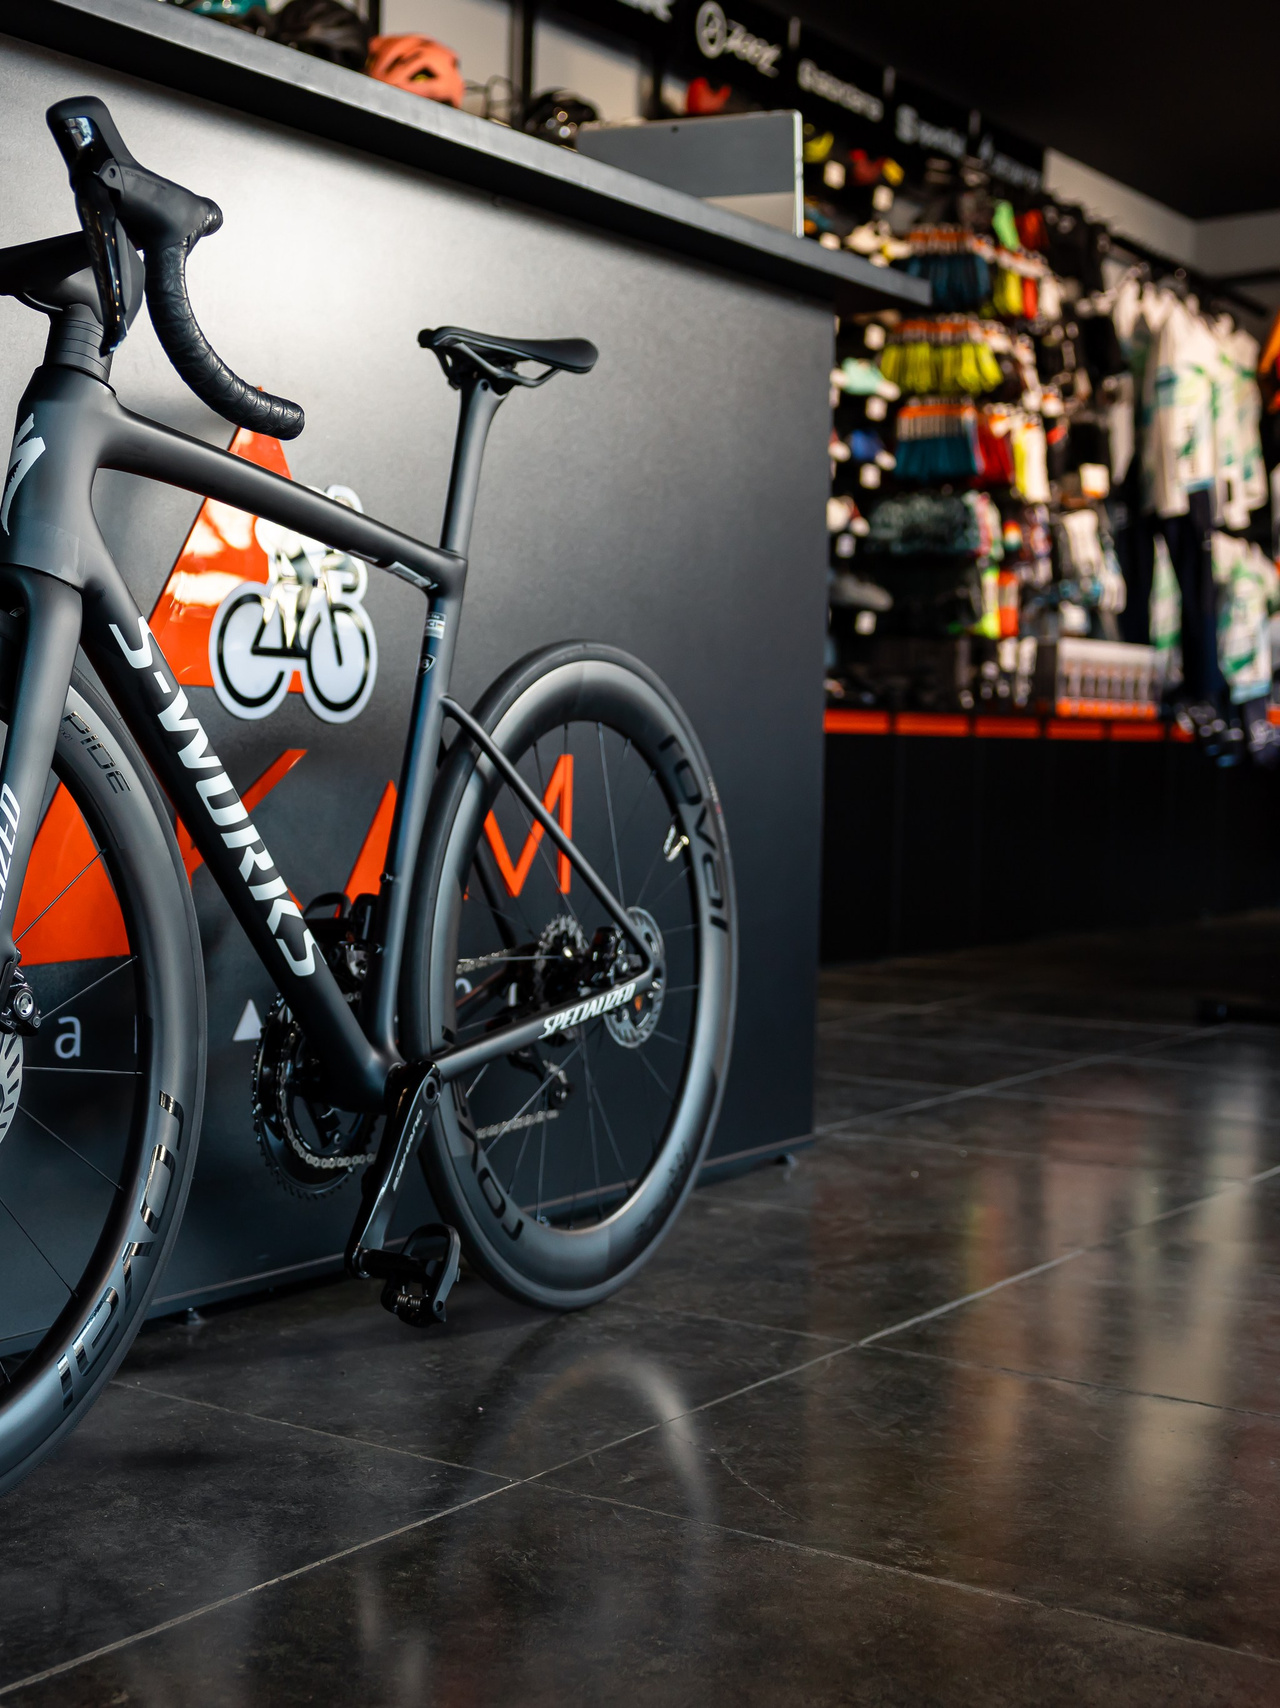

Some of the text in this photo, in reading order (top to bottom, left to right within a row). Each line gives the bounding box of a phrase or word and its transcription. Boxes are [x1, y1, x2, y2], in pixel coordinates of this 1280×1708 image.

[62, 710, 131, 794] PIDE
[108, 615, 327, 977] S-WORKS
[656, 733, 729, 933] roval
[537, 982, 637, 1040] SPECIALIZED
[55, 1089, 185, 1411] roval
